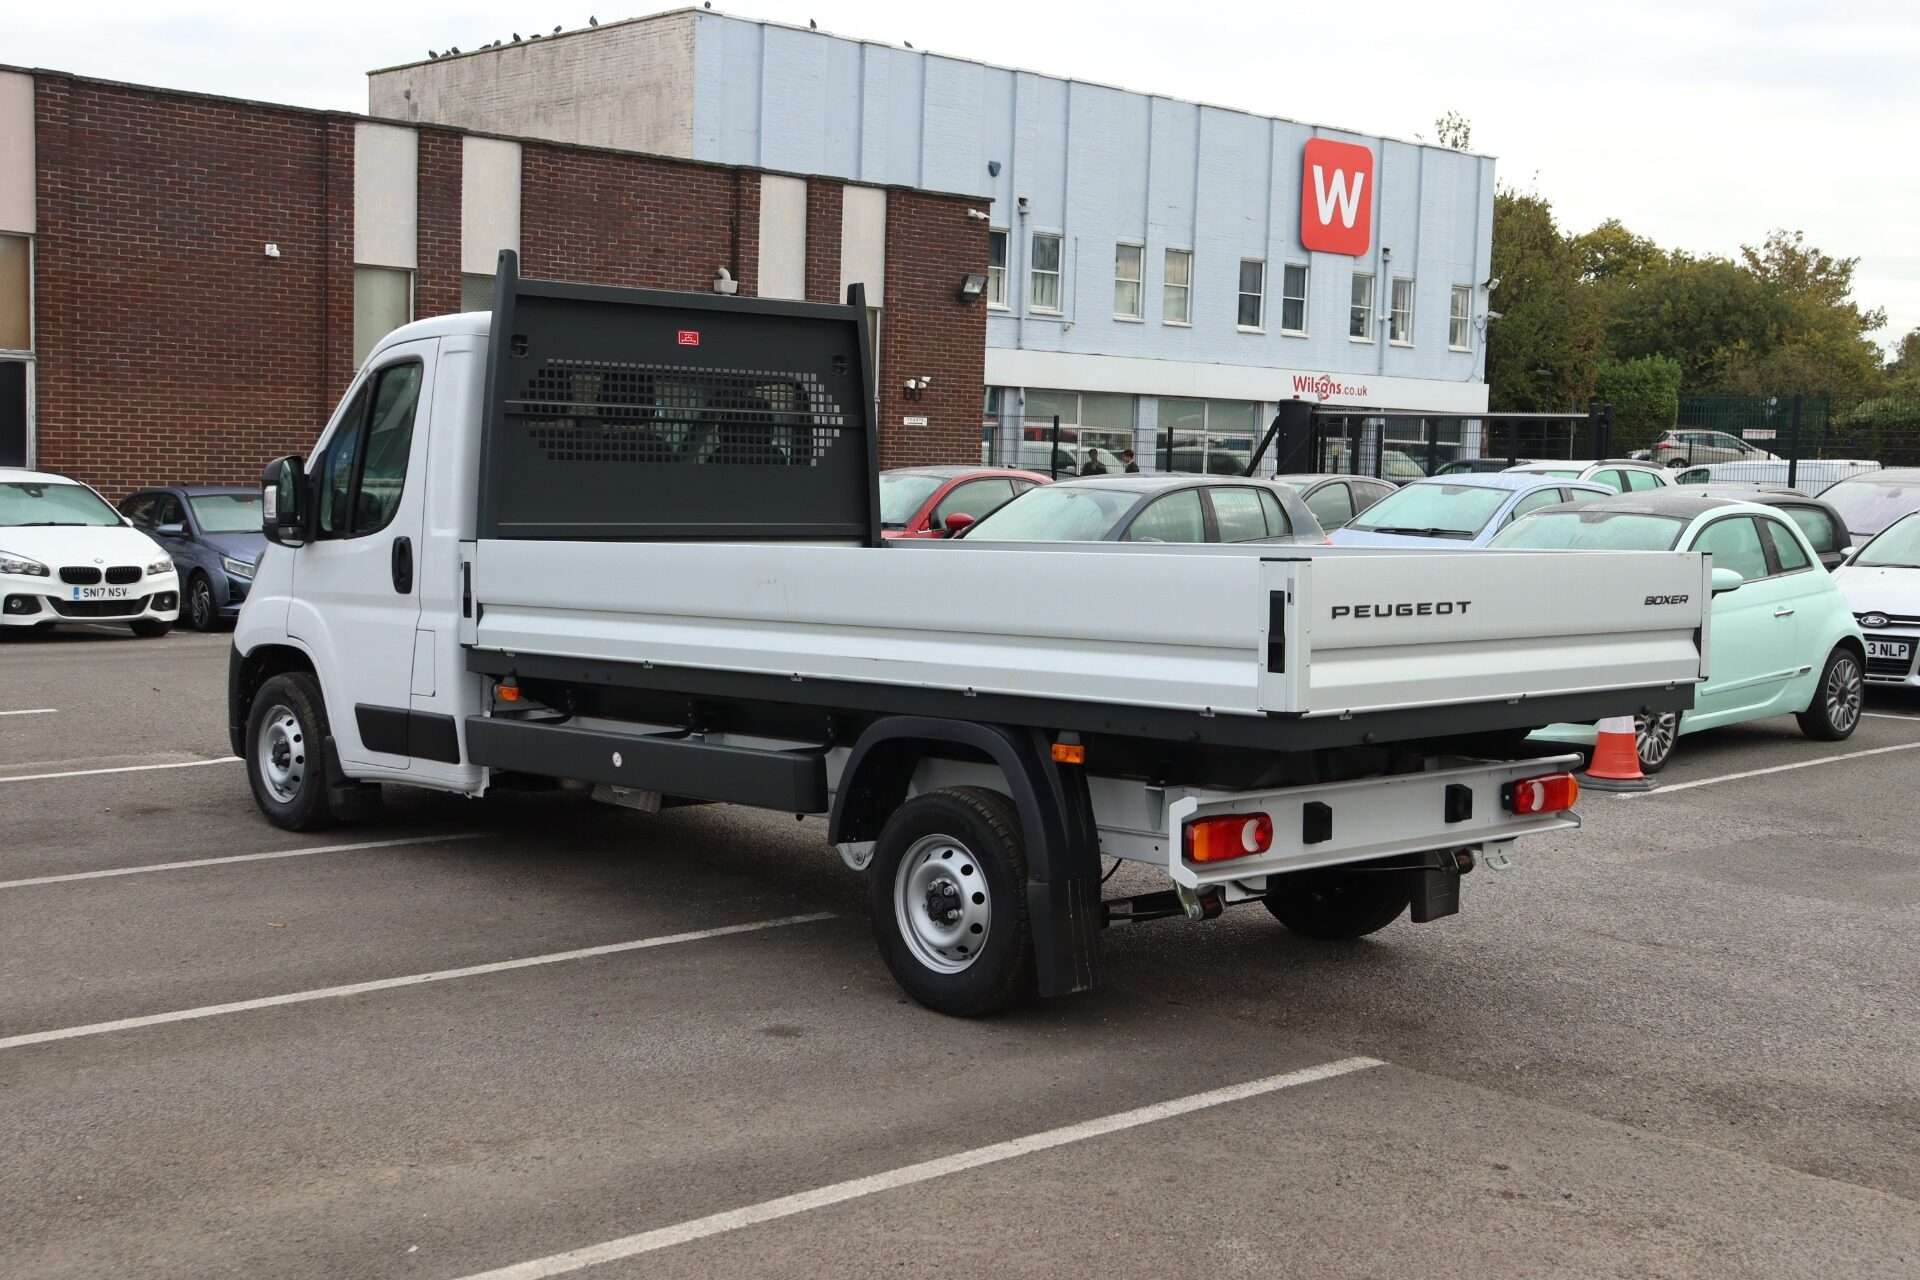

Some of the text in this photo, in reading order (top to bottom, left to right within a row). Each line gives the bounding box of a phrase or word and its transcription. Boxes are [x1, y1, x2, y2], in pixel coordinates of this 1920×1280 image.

[1312, 164, 1365, 229] W
[1293, 375, 1368, 398] Wilsons.co.uk
[83, 587, 127, 598] SN17 NSV
[1644, 594, 1689, 606] BOXER
[1331, 600, 1472, 619] PEUGEOT
[1880, 643, 1907, 657] NLP
